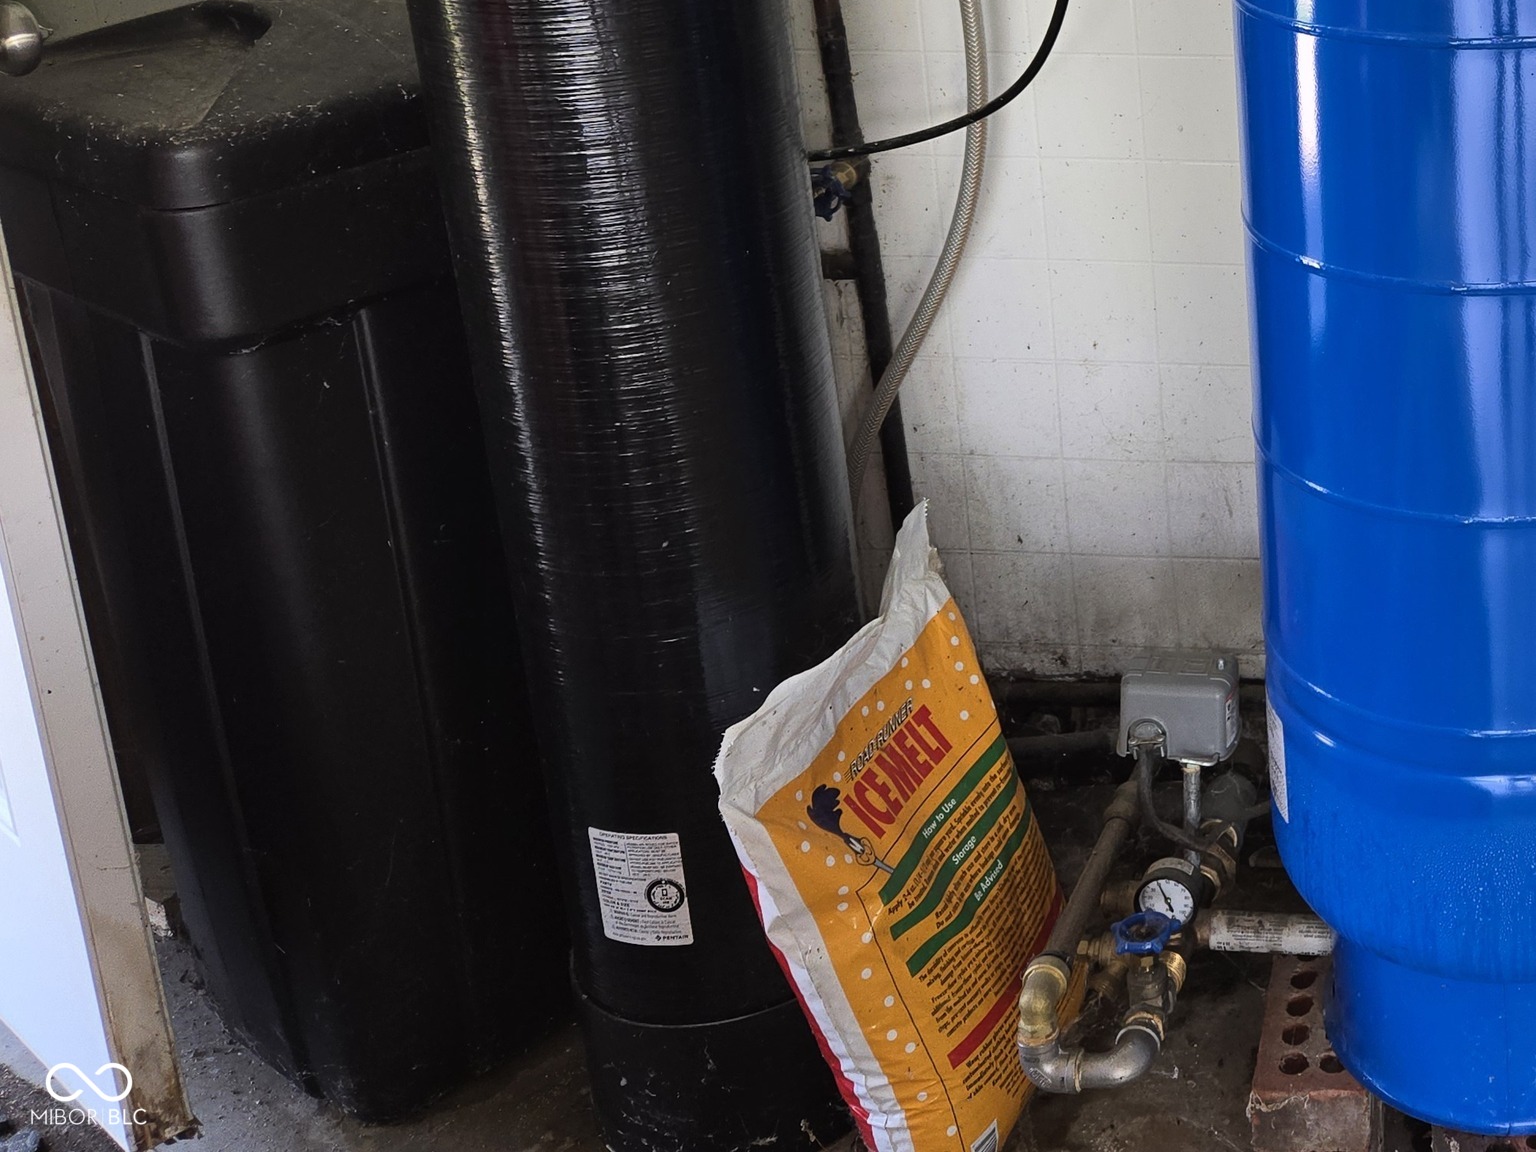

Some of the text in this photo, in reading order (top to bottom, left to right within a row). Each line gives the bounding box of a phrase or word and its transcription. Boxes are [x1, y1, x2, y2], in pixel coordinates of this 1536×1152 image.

[850, 698, 913, 781] ROAD RUNNER
[921, 798, 957, 839] How to Use
[951, 835, 977, 866] Storage
[974, 860, 1004, 902] Be Advised
